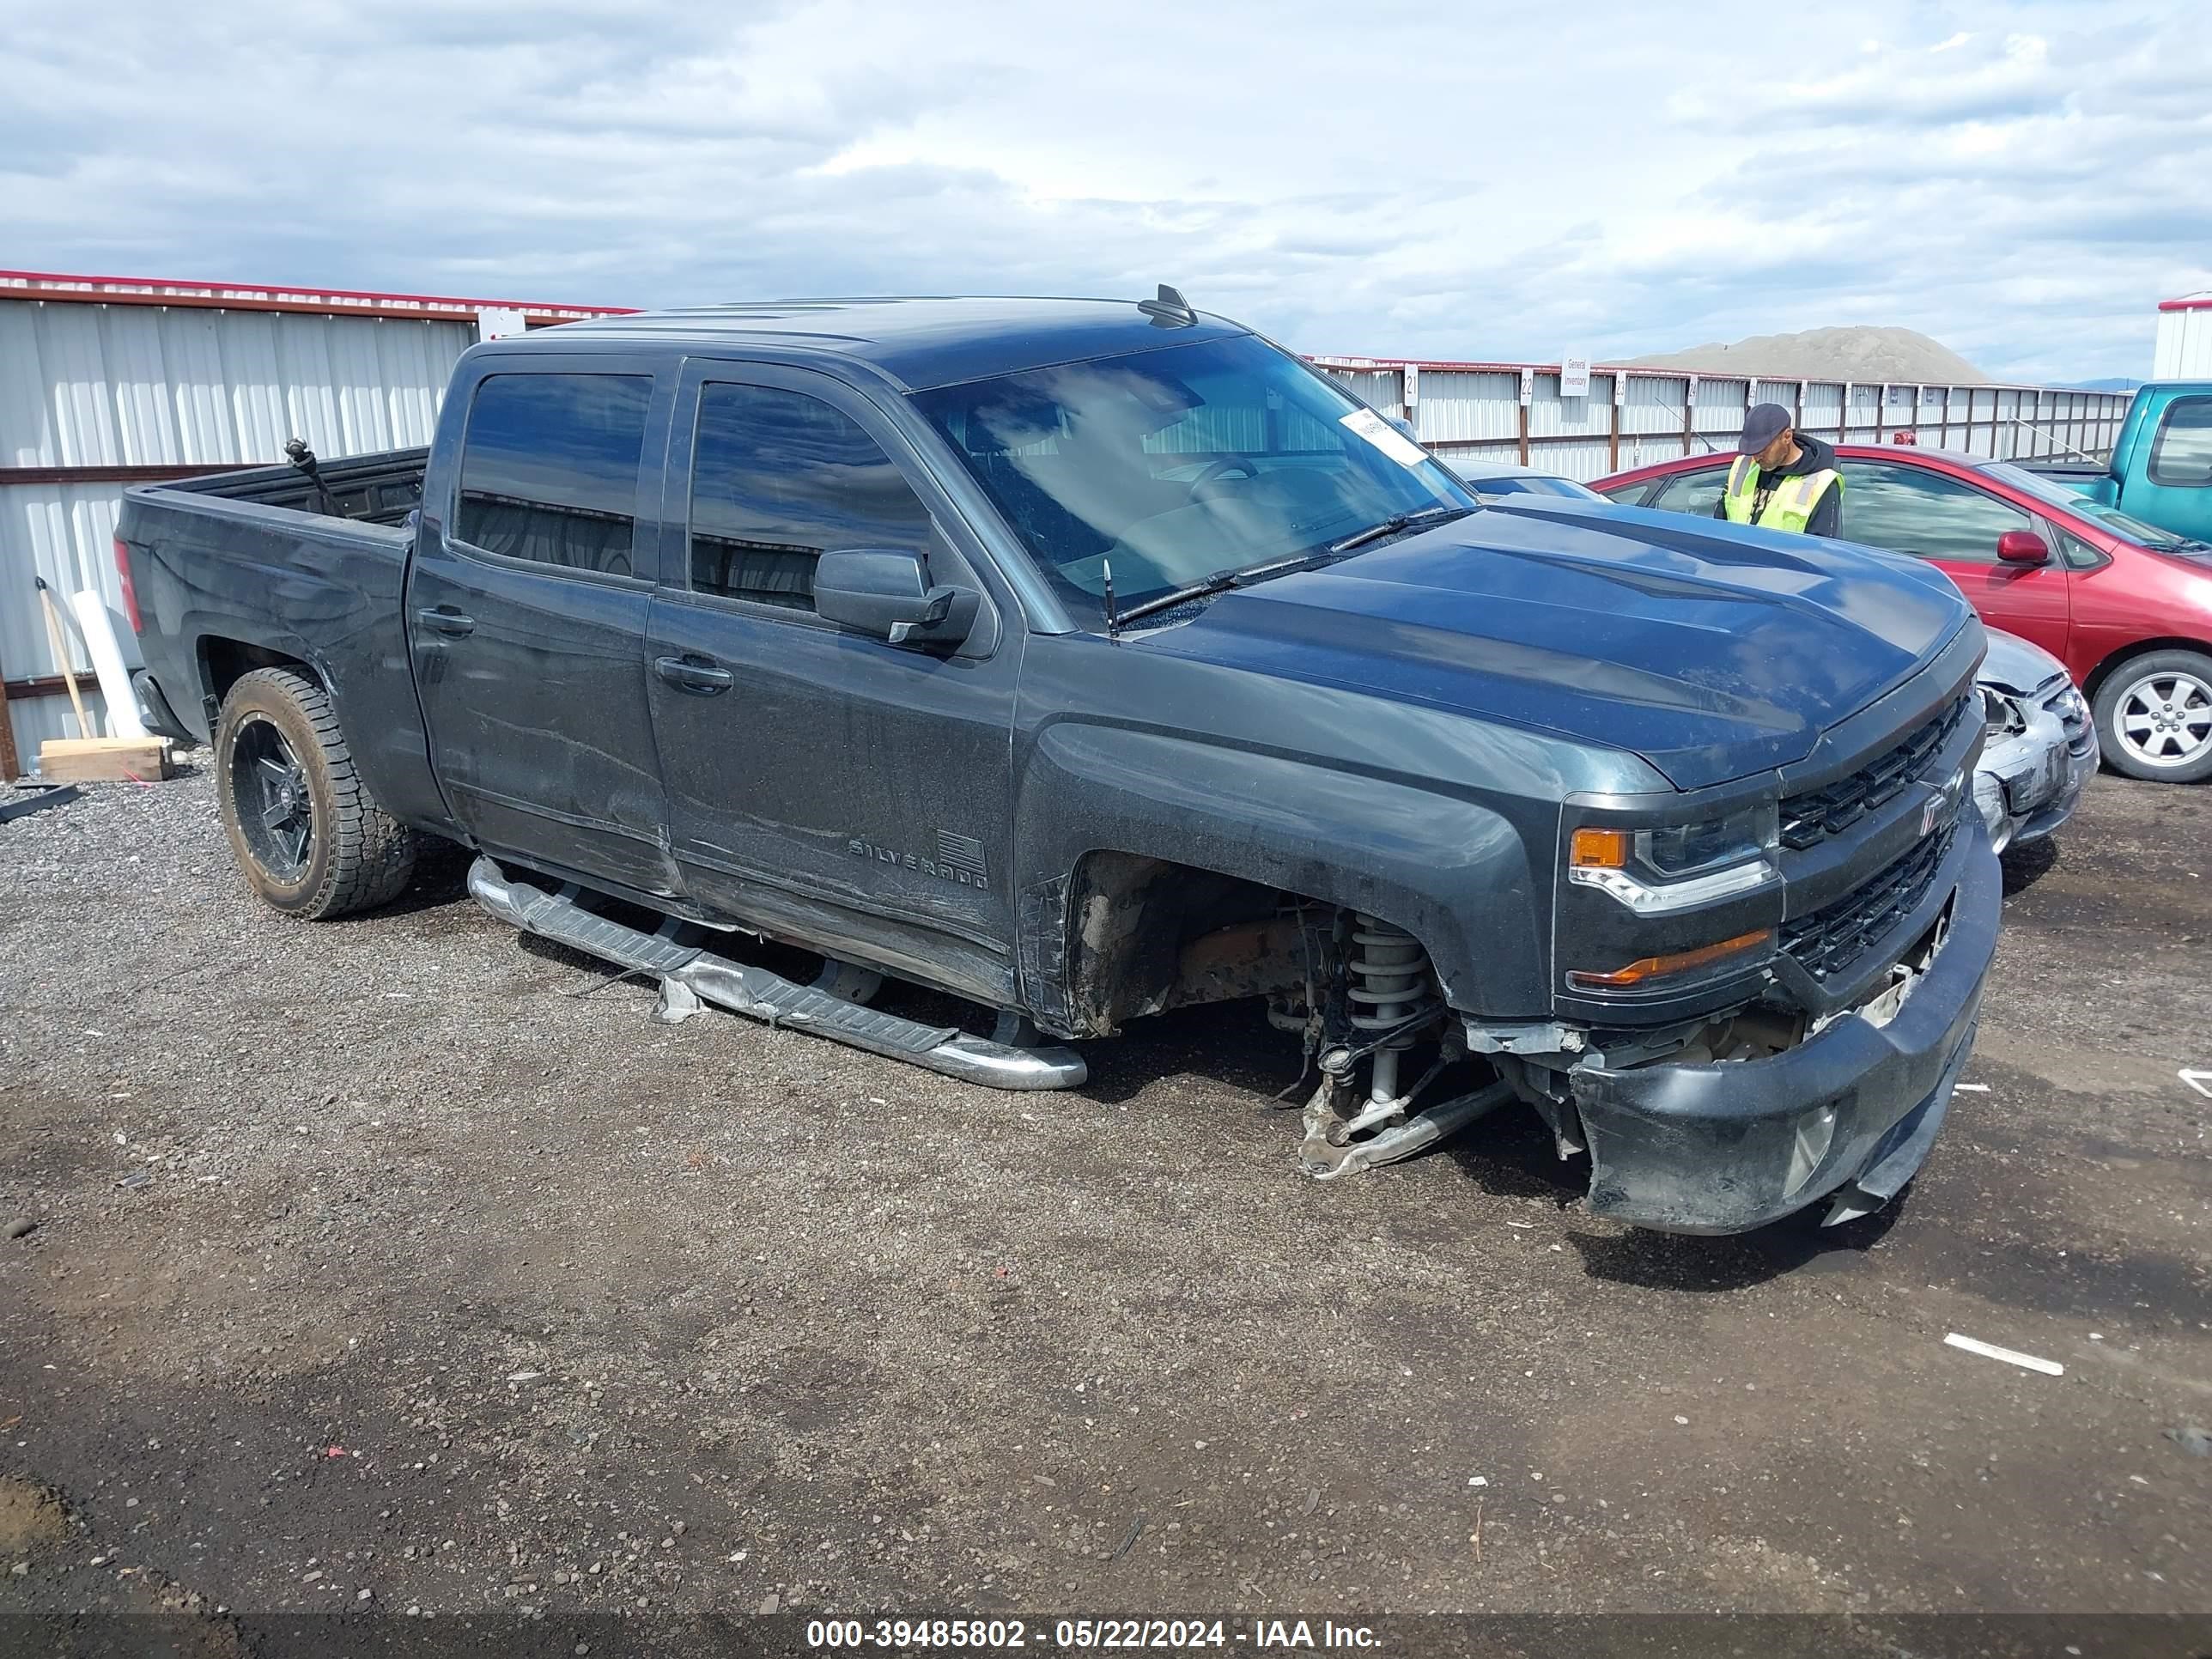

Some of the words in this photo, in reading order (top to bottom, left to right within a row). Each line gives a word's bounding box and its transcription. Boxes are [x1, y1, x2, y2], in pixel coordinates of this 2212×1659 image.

[1568, 358, 1586, 369] General
[1407, 375, 1417, 394] 21
[1522, 378, 1532, 395] 22
[1565, 375, 1587, 387] Inventory
[1616, 380, 1625, 396] 23
[848, 838, 989, 890] SILVERADO
